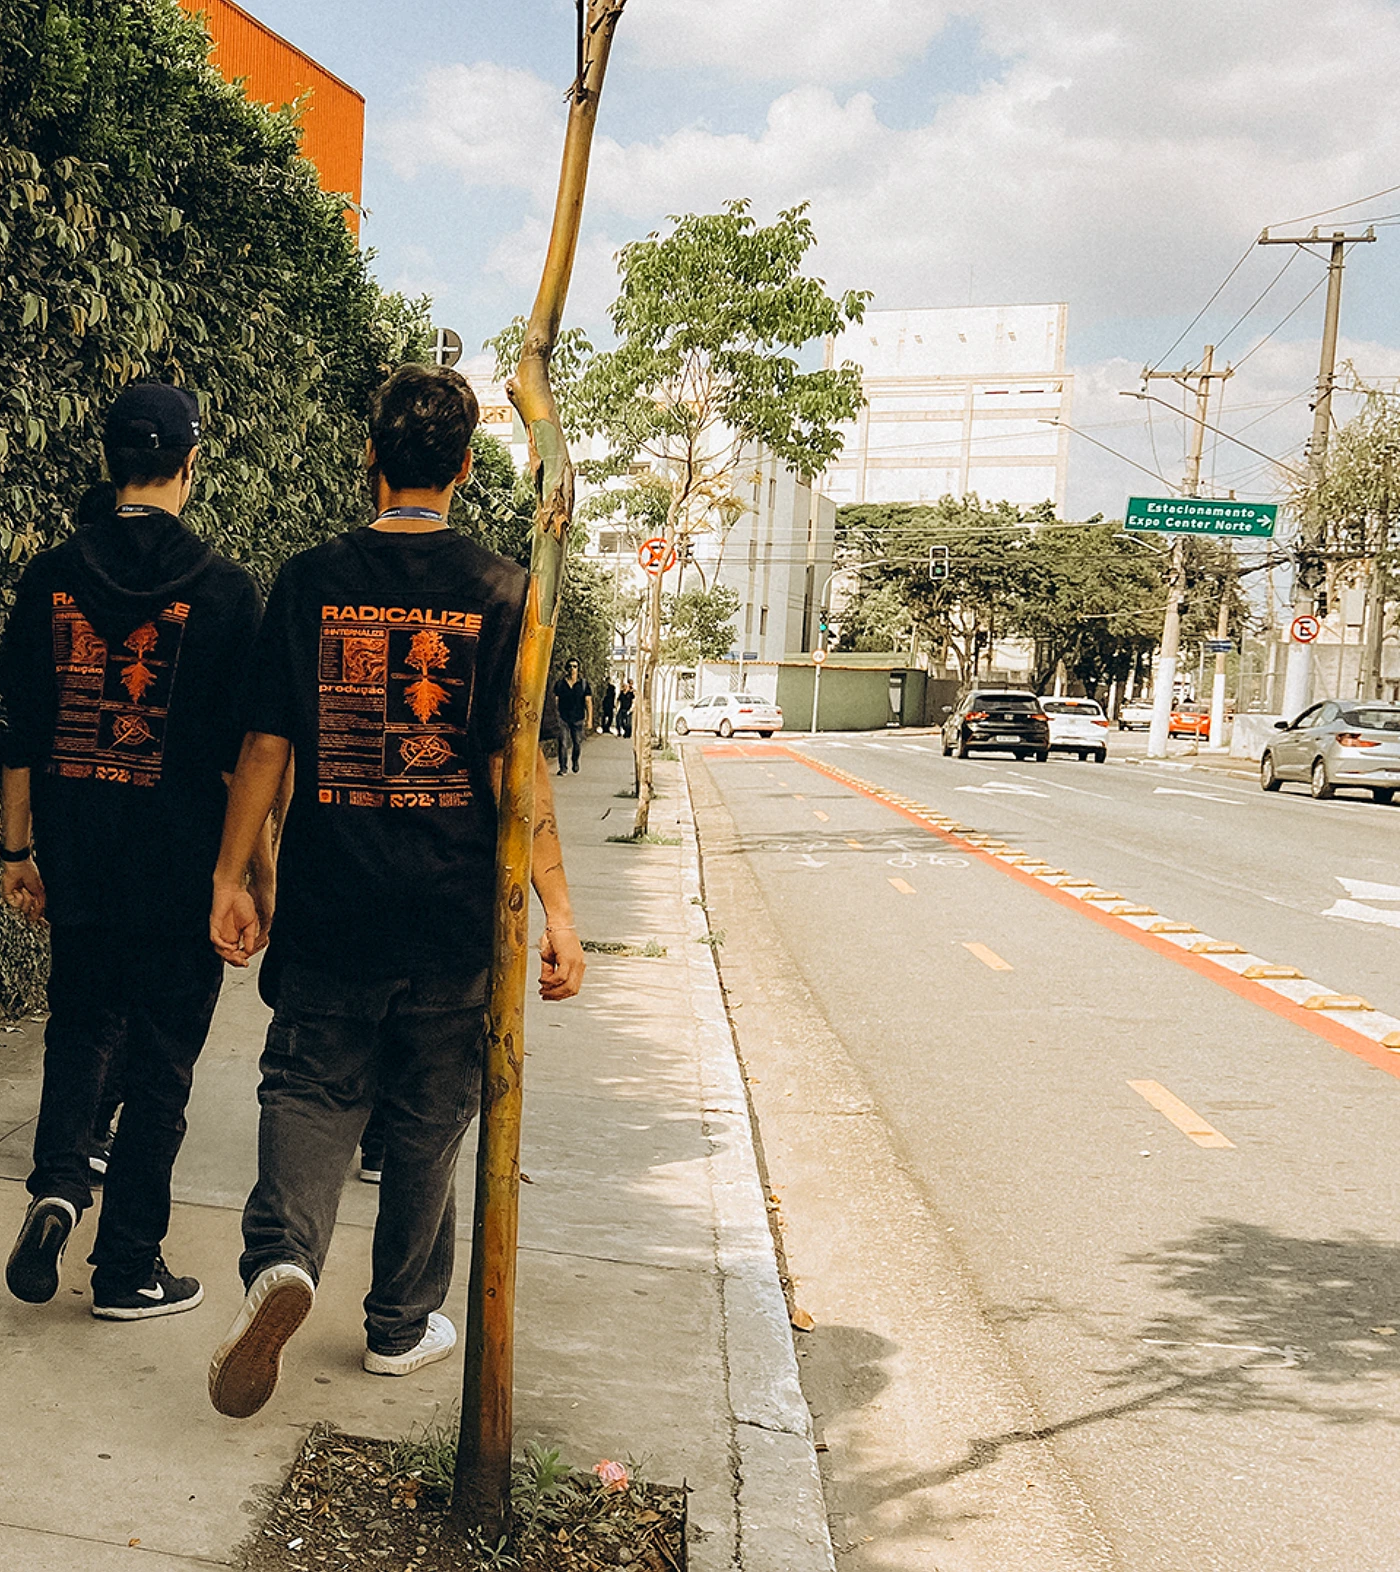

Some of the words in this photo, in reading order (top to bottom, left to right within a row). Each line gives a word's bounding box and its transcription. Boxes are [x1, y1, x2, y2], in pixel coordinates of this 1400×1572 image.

[1146, 502, 1256, 519] Estacionamento
[1128, 515, 1160, 528] Expo
[1165, 517, 1211, 530] Center
[1214, 519, 1253, 532] Norte
[321, 605, 484, 630] RADICALIZE
[318, 684, 386, 696] produção
